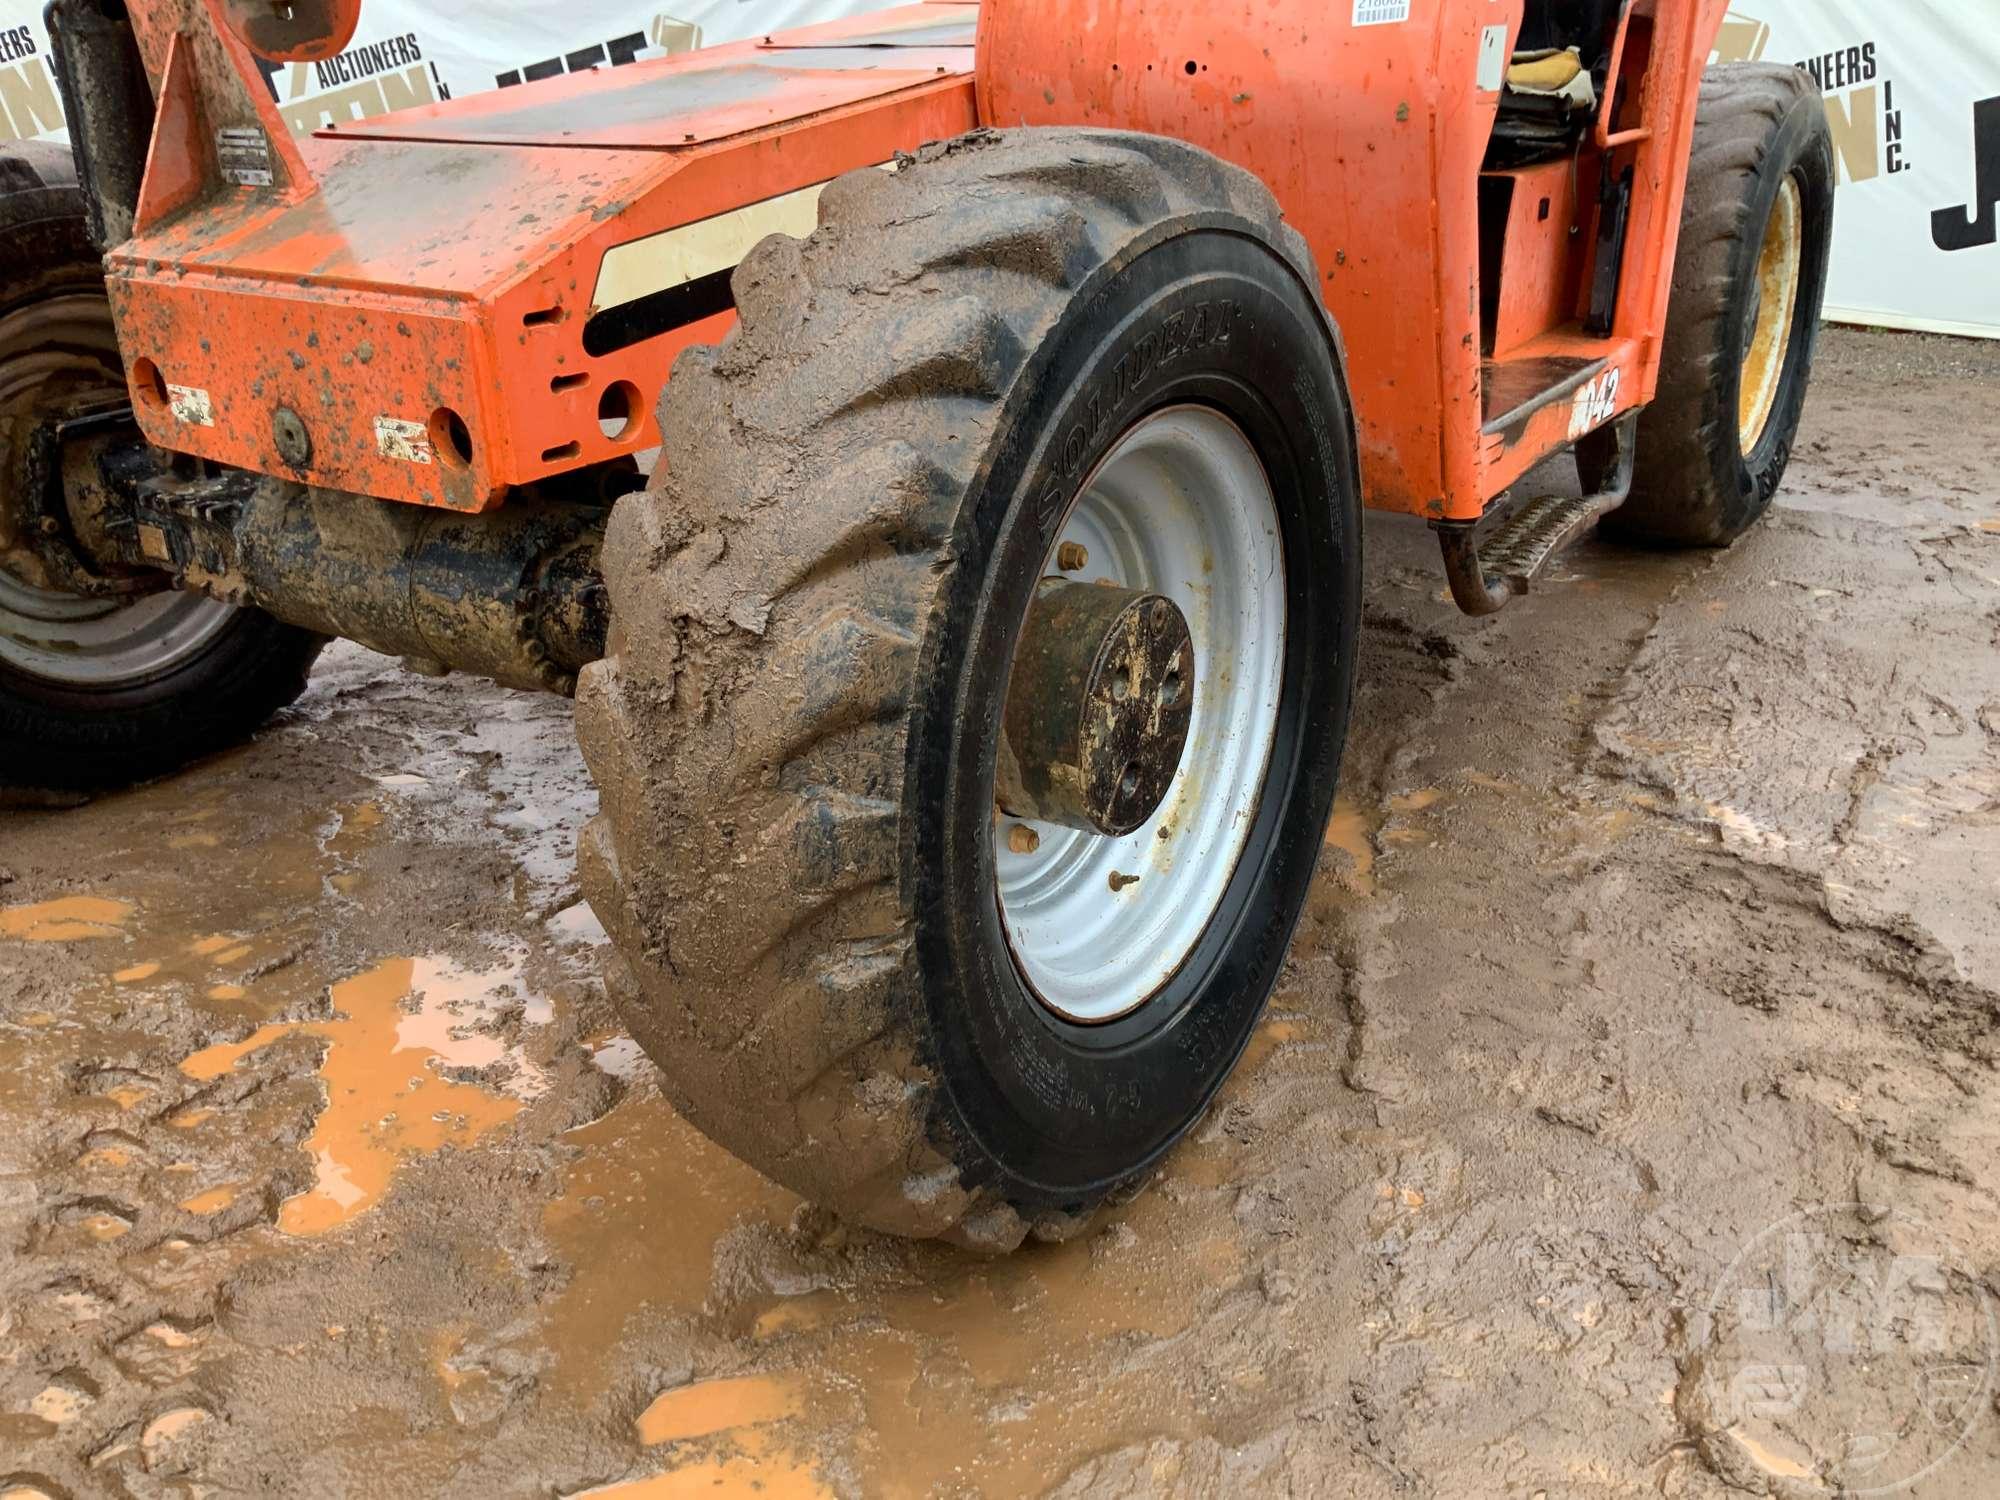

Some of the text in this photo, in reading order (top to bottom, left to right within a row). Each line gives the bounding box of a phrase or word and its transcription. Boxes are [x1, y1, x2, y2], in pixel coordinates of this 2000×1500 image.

[316, 33, 422, 89] AUCTIONEERS
[1794, 41, 1877, 92] NEERS
[1035, 298, 1233, 538] SOLIDEAL
